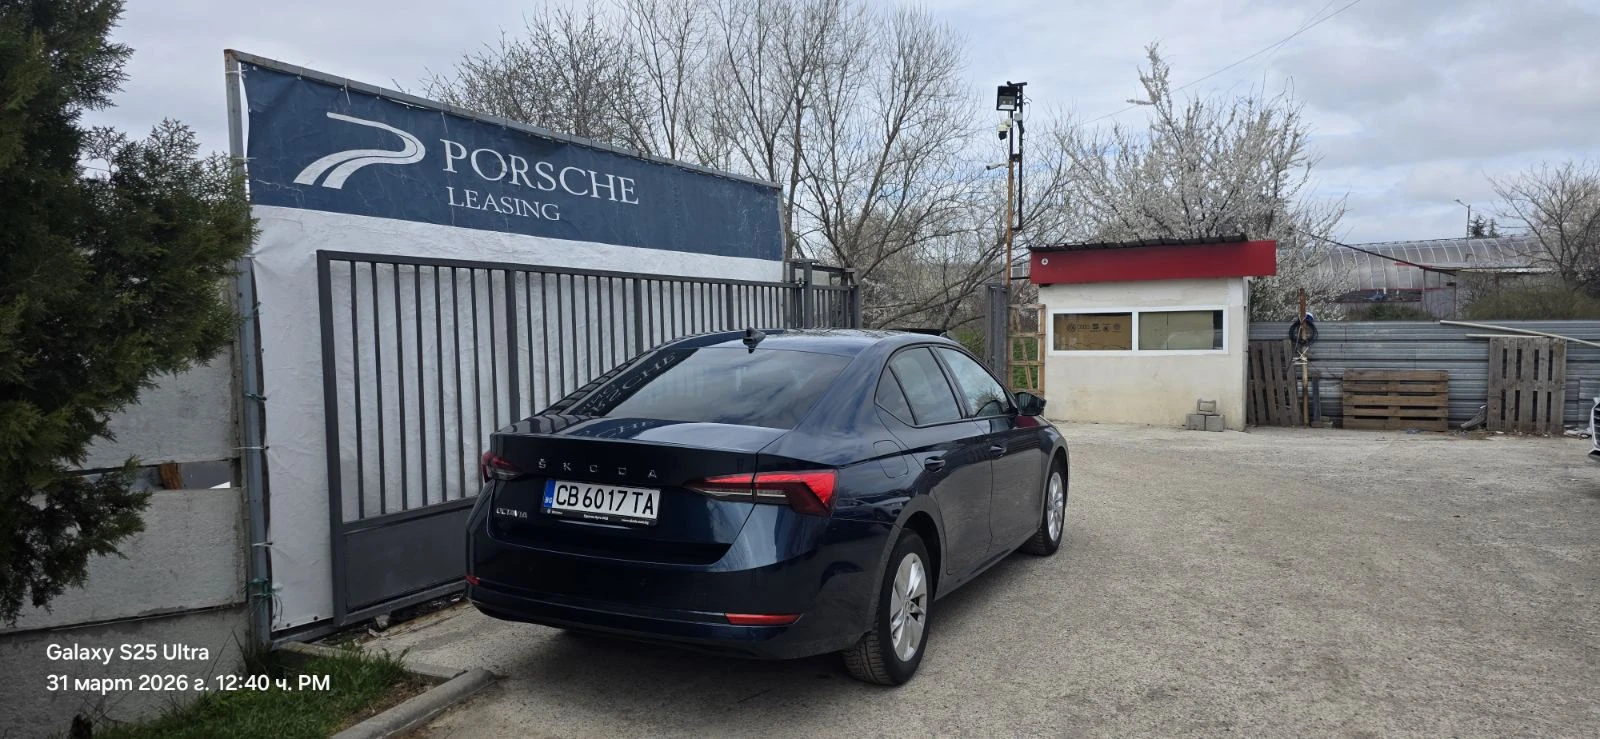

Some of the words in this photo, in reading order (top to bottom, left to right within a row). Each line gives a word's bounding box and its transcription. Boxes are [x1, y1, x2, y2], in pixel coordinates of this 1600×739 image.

[440, 138, 638, 205] PORSCHE
[447, 186, 560, 221] LEASING
[556, 484, 579, 507] CB
[582, 487, 628, 512] 6017
[632, 491, 654, 516] TA
